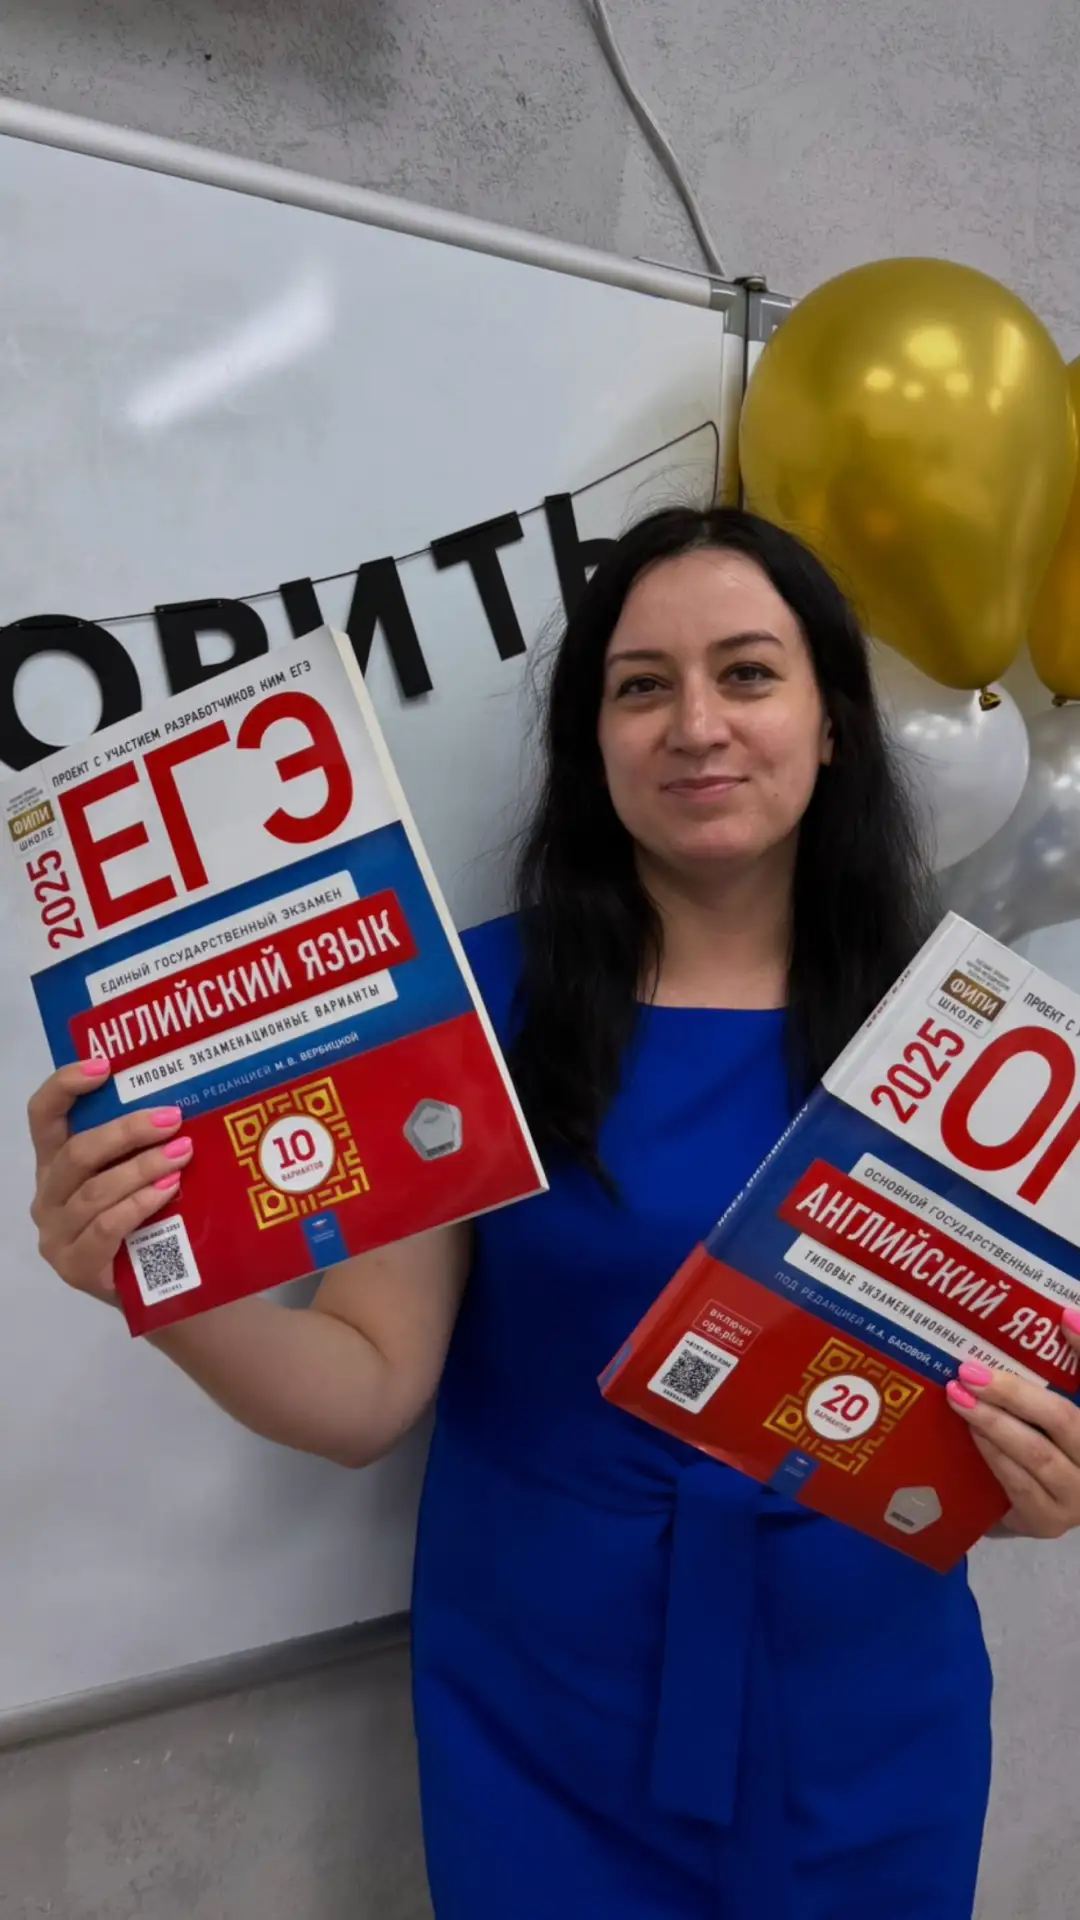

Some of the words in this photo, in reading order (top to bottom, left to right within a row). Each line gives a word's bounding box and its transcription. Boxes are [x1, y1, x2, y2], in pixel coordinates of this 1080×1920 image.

[52, 760, 90, 788] ПРОЕКТ
[93, 755, 102, 767] С
[105, 729, 161, 761] УЧАСТИЕМ
[165, 685, 256, 734] РАЗРАБОТЧИКОВ
[260, 671, 287, 692] КИМ
[290, 660, 312, 679] ЕГЭ
[13, 806, 50, 834] ФИПИ
[19, 827, 54, 851] ШКОЛЕ
[58, 691, 353, 931] ЕГЭ
[26, 849, 85, 949] 2025
[101, 959, 151, 994] ЕДИНЫЙ
[154, 911, 278, 979] ГОСУДАРСТВЕННЫЙ
[281, 888, 343, 924] ЭКЗАМЕН
[87, 946, 291, 1060] АНГЛИЙСКИЙ
[304, 910, 401, 982] ЯЗЫК
[938, 996, 984, 1030] ШКОЛЕ
[950, 978, 998, 1016] ФИПИ
[1023, 992, 1066, 1023] ПРОЕКТ
[1065, 1019, 1075, 1031] С
[129, 1059, 184, 1088] ТИПОВЫЕ
[190, 1010, 310, 1066] ЭКЗАМЕНАЦИОННЫЕ
[315, 983, 380, 1019] ВАРИАНТЫ
[203, 1065, 272, 1098] РЕДАКЦИЕЙ
[299, 1031, 360, 1061] ВЕРБИЦКОЙ
[871, 1017, 966, 1124] 2025
[272, 1129, 317, 1169] 10
[281, 1160, 325, 1182] ВАРИАНТОВ
[796, 1181, 1012, 1320] АНГЛИЙСКИЙ
[864, 1167, 928, 1214] ОСНОВНОЙ
[929, 1205, 1043, 1283] ГОСУДАРСТВЕННЫЙ
[702, 1319, 745, 1348] oge.plus
[774, 1271, 799, 1291] ПОД
[801, 1288, 865, 1327] РЕДАКЦИЕЙ
[887, 1335, 932, 1366] БАСОВОЙ,
[804, 1249, 857, 1286] ТИПОВЫЕ
[858, 1281, 966, 1349] ЭКЗАМЕНАЦИОННЫЕ
[813, 1408, 852, 1434] ВАРИАНТОВ
[820, 1384, 870, 1422] 20
